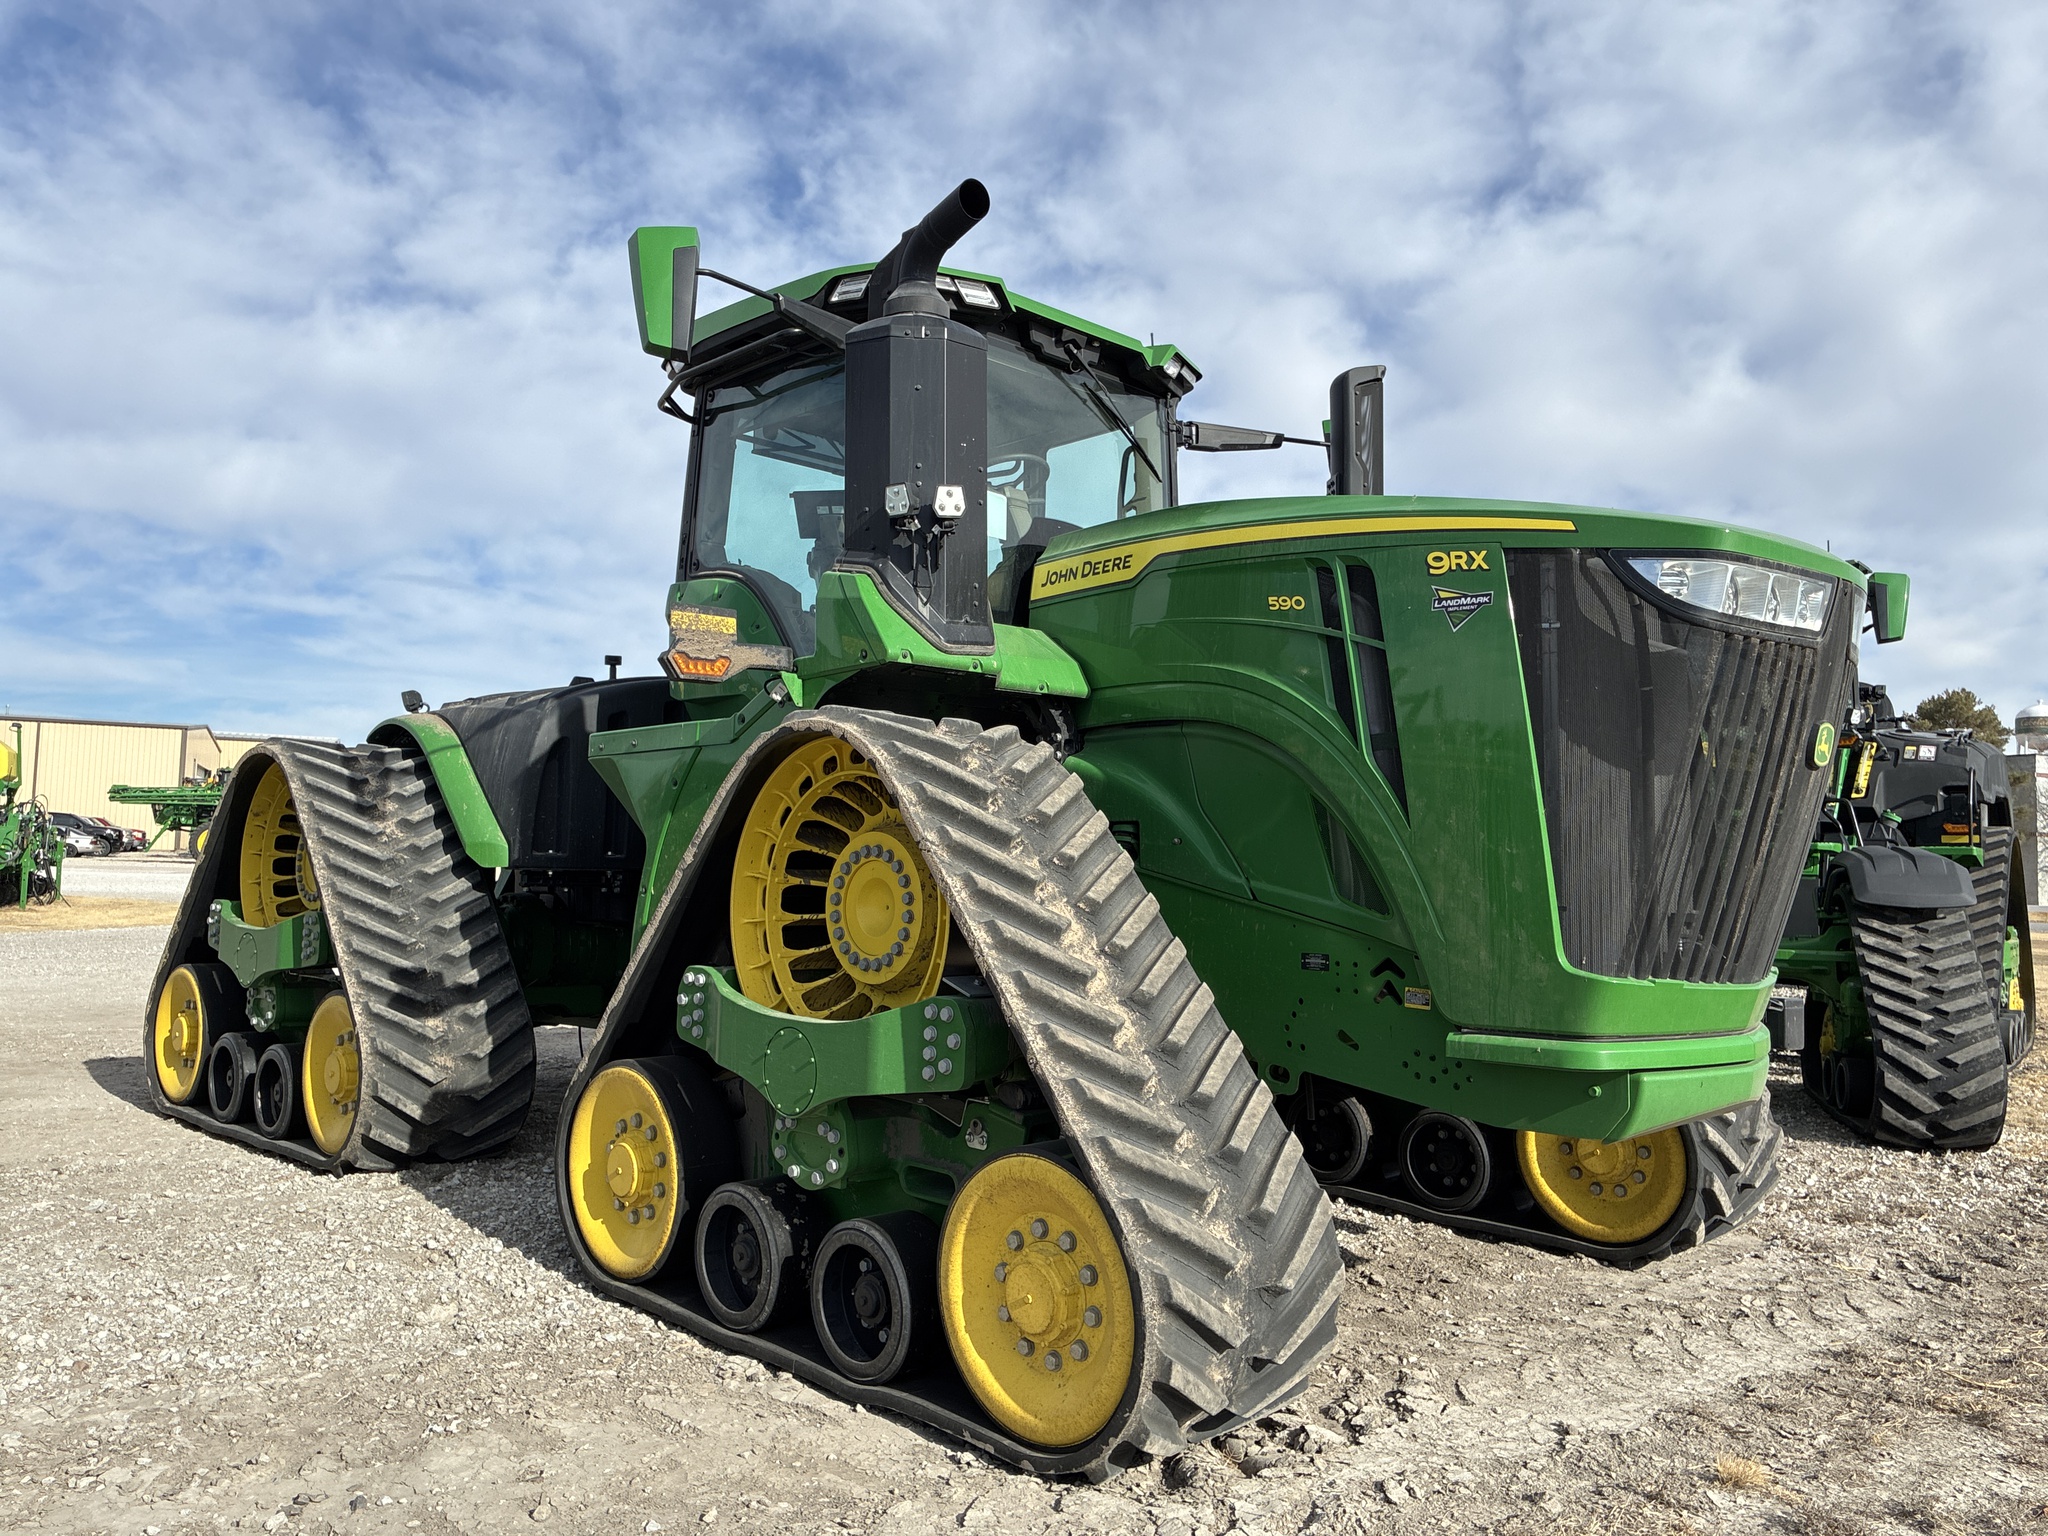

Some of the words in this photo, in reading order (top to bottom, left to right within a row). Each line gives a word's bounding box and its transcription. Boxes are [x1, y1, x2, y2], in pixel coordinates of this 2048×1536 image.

[1426, 550, 1490, 575] 9RX
[1041, 566, 1079, 588] JOHN
[1081, 554, 1134, 579] DEERE
[1267, 595, 1306, 611] 590
[1434, 595, 1490, 608] LANDMARK
[1447, 604, 1478, 612] IMPLEMENT
